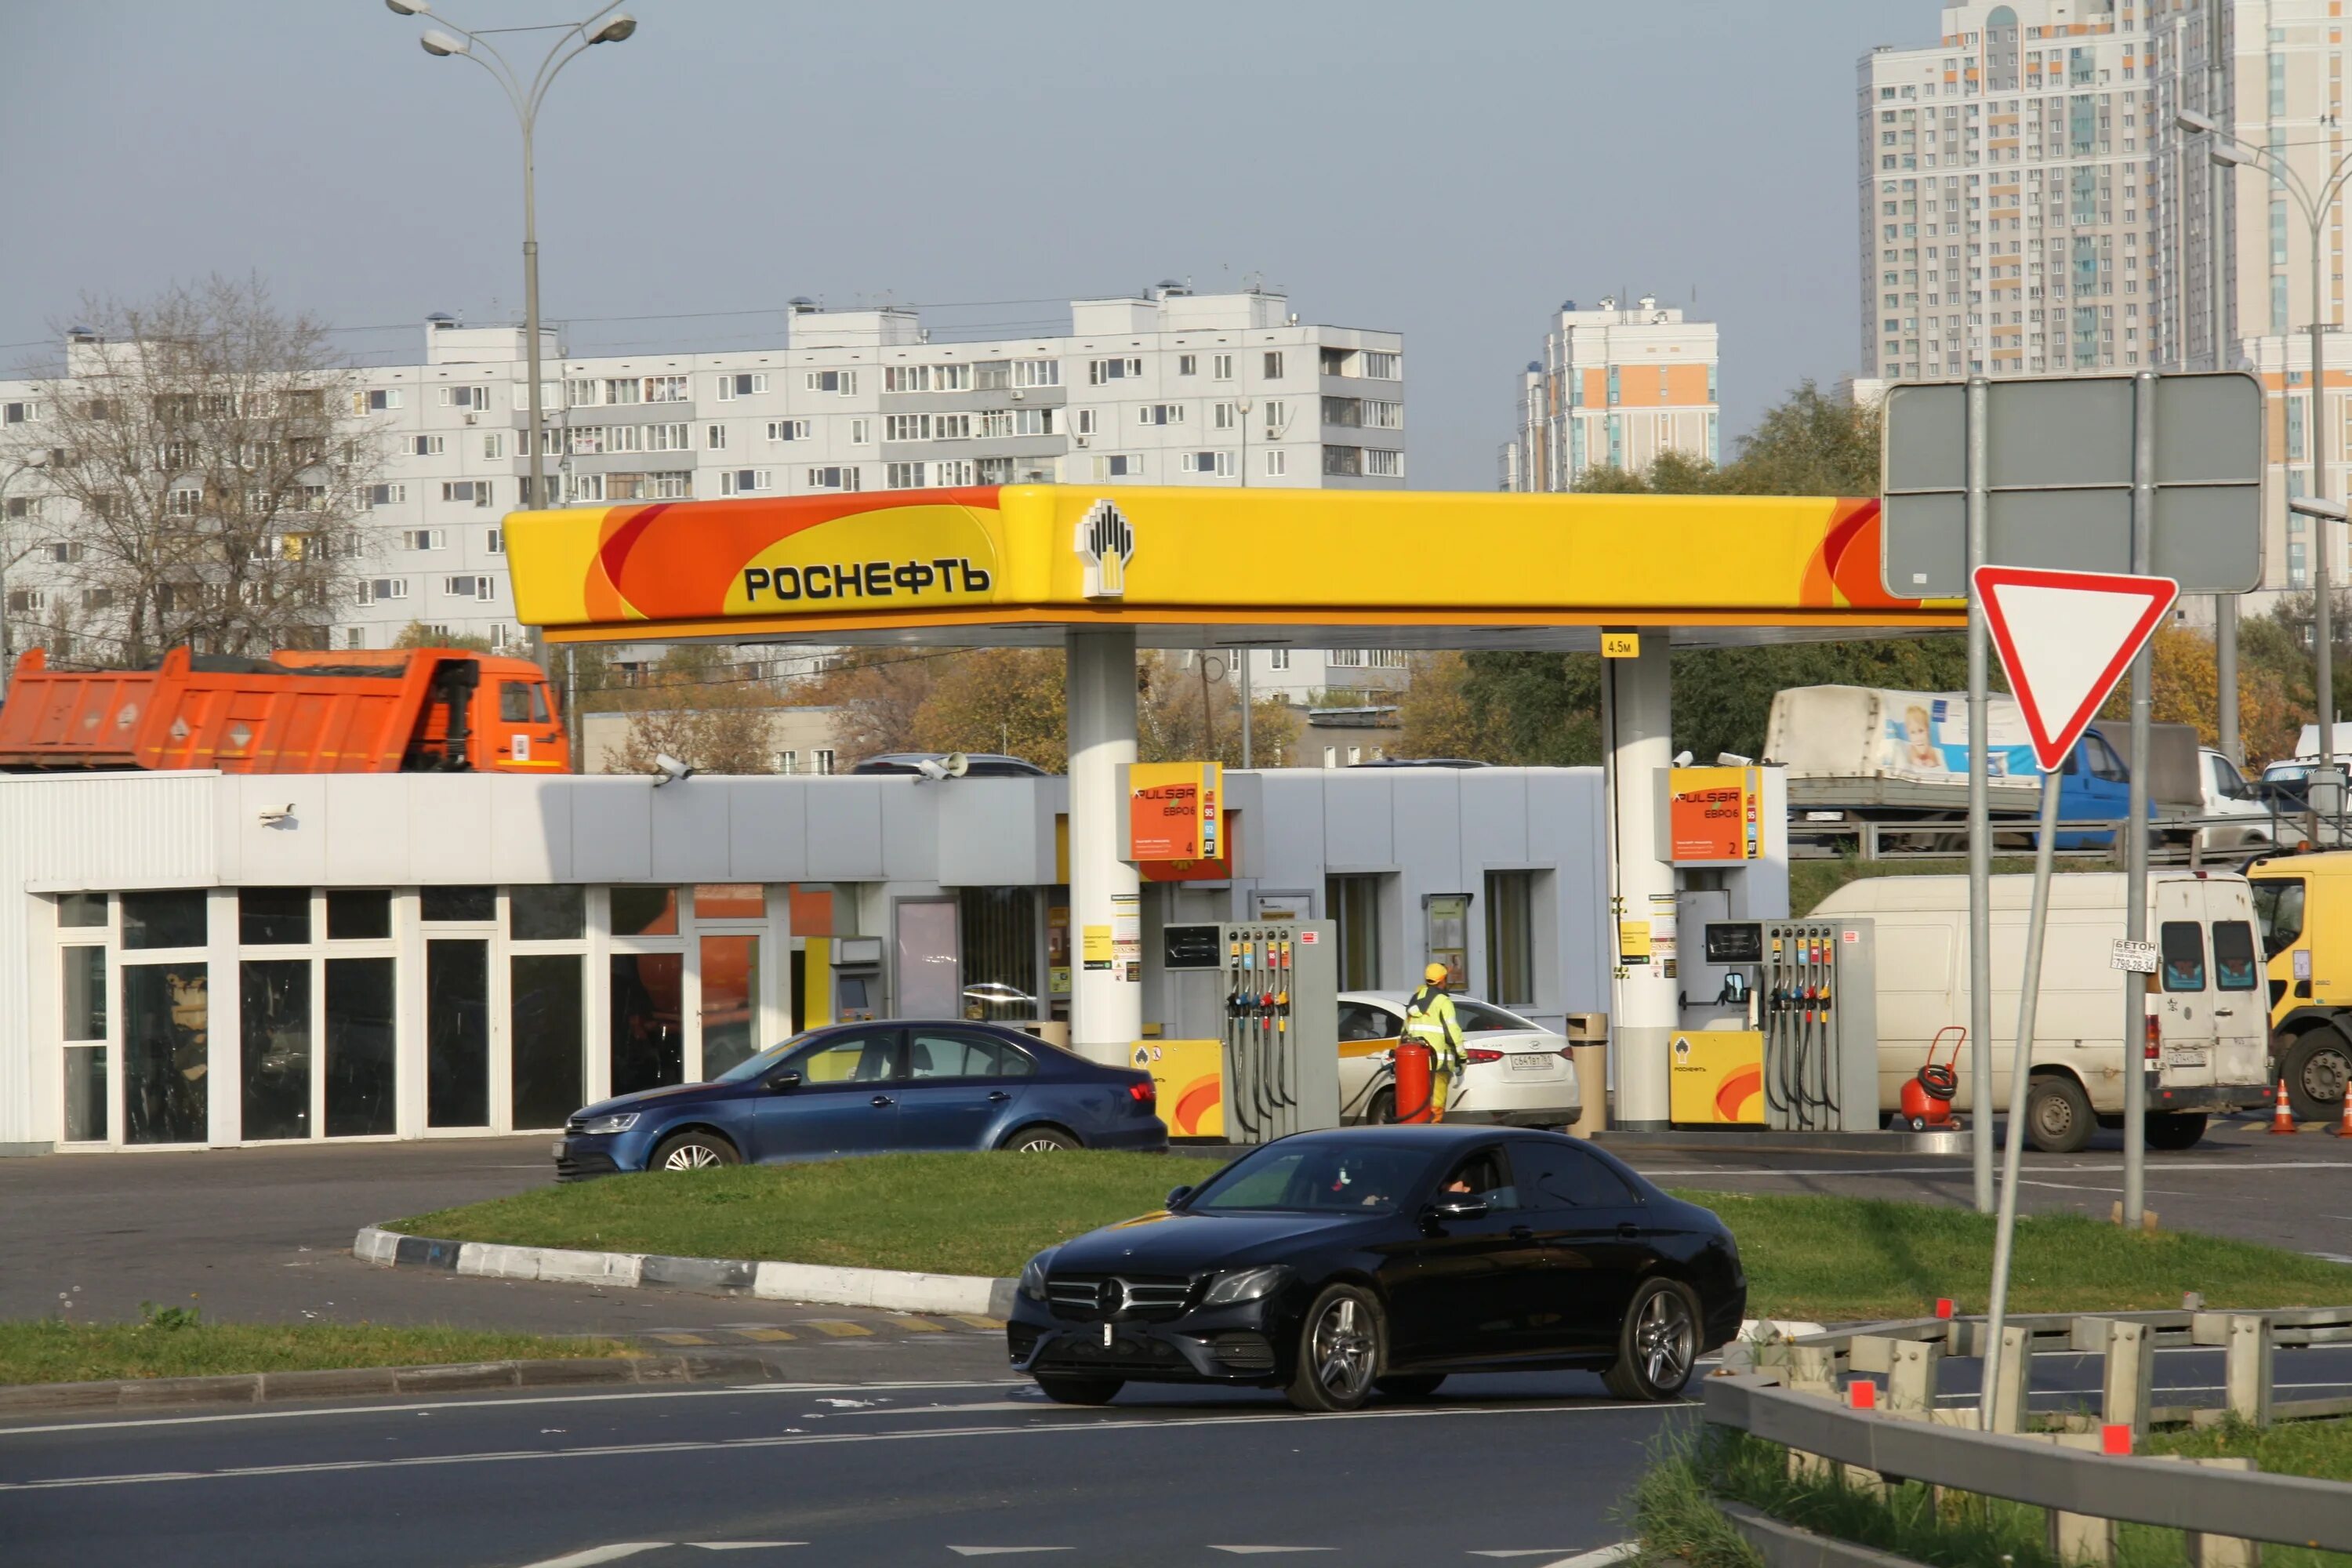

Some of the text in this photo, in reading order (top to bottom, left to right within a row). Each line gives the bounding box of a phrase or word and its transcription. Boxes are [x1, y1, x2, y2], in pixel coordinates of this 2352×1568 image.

[744, 557, 990, 601] РОСНЕФТЬ
[1185, 841, 1193, 854] 4
[1204, 841, 1214, 851] ДТ
[1729, 842, 1736, 855] 2
[2116, 941, 2155, 951] БЕТОН
